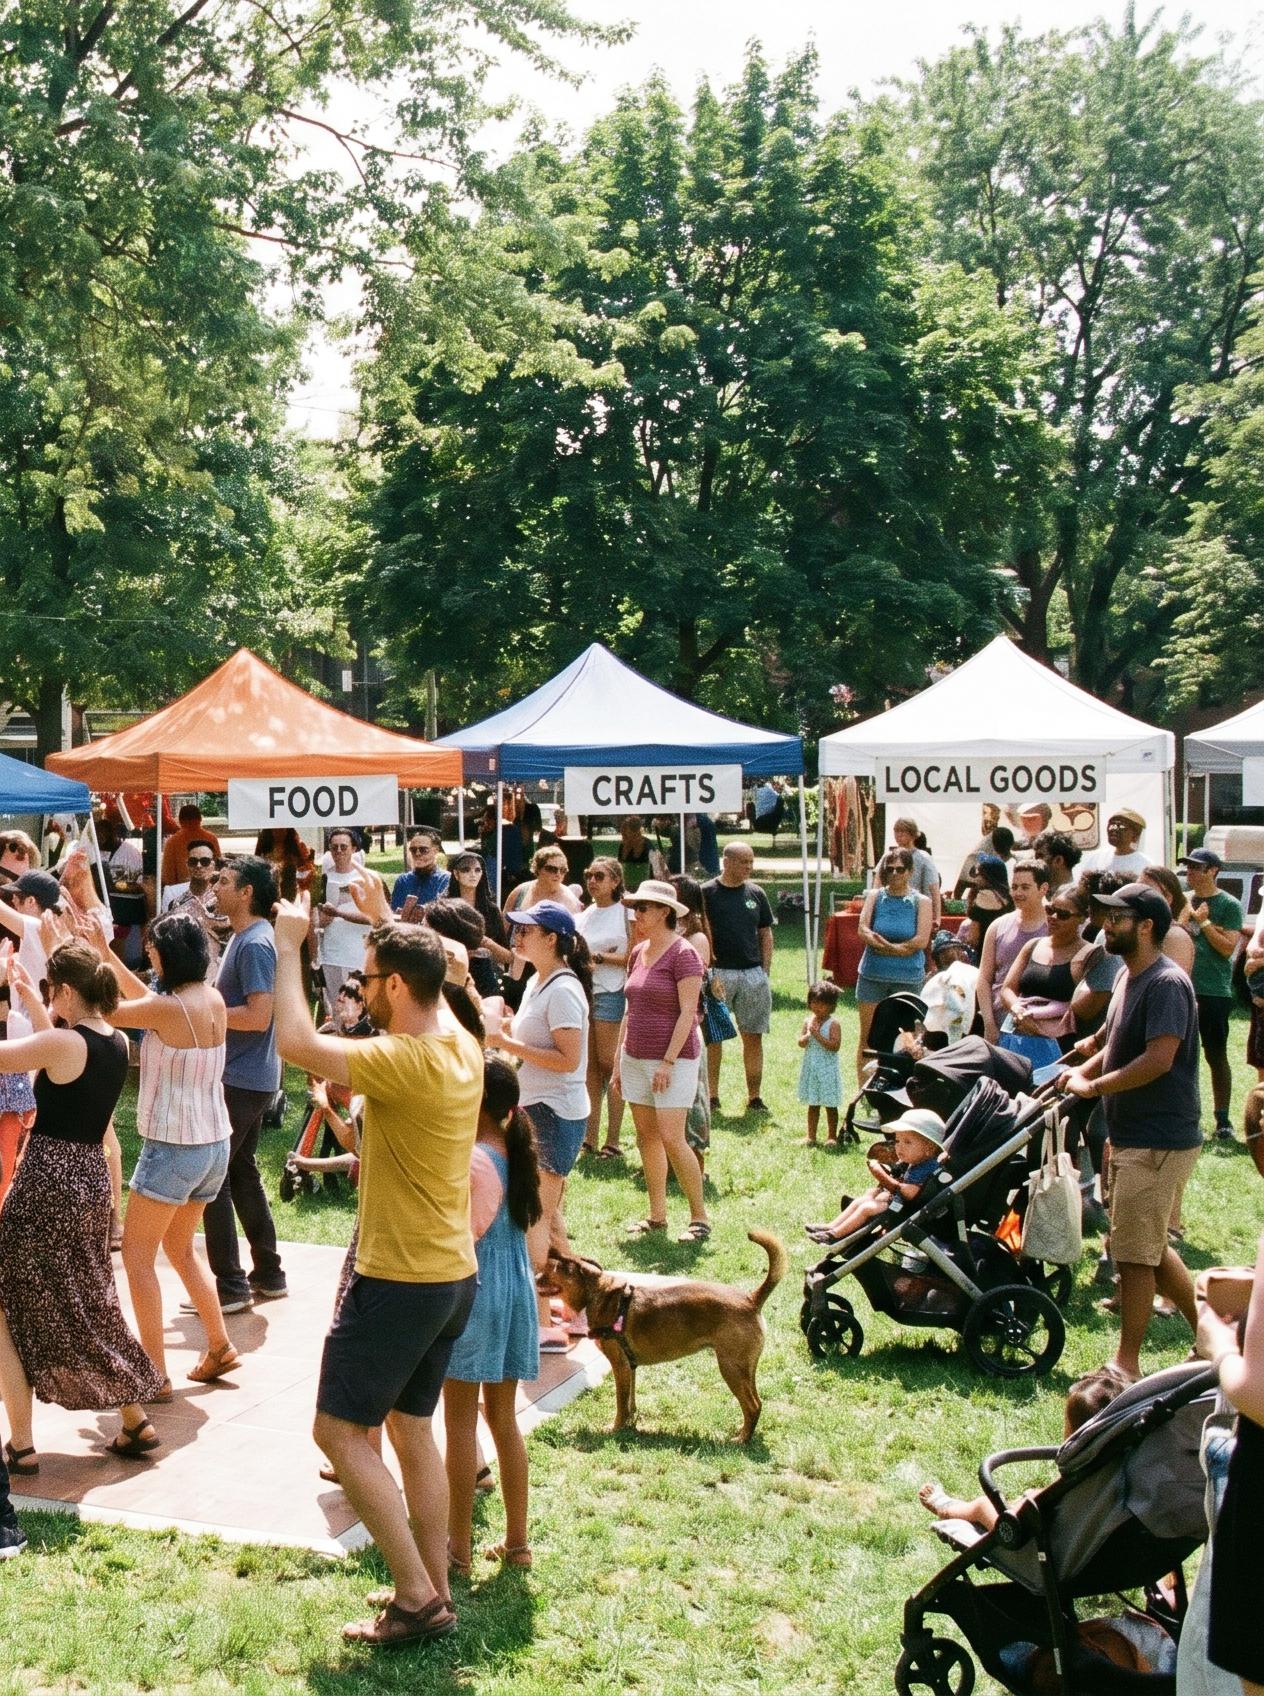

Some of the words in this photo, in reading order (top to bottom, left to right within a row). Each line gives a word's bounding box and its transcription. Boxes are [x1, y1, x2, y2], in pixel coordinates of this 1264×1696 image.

[592, 773, 716, 807] CRAFTS
[885, 765, 981, 794] LOCAL
[989, 764, 1097, 794] GOODS
[268, 785, 359, 819] FOOD
